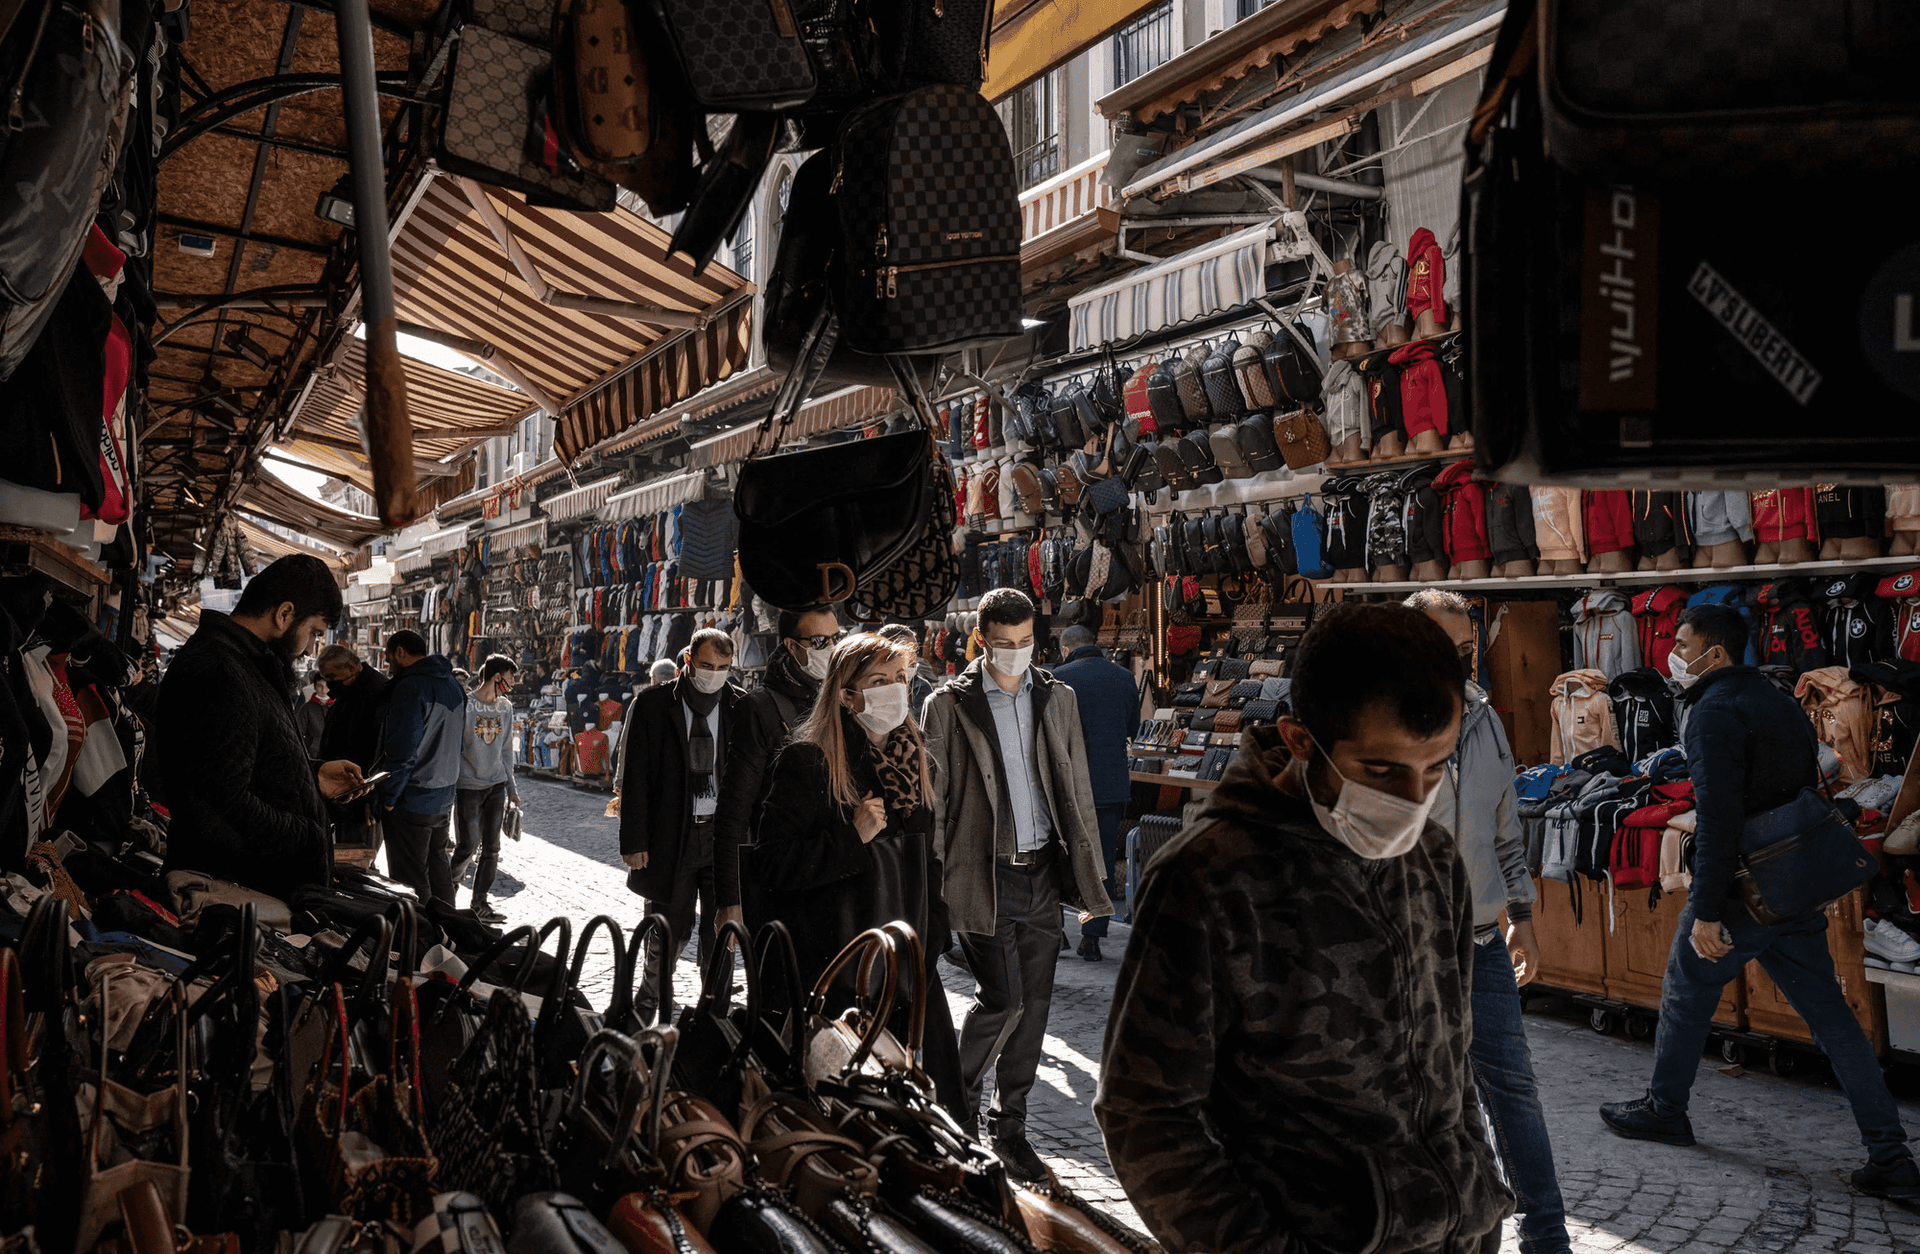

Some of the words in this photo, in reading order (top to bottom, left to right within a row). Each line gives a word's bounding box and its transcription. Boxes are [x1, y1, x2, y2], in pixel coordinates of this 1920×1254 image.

[101, 423, 119, 471] adida
[1753, 498, 1776, 508] ANEL
[1817, 493, 1840, 504] ANEL
[1878, 752, 1898, 763] NEL
